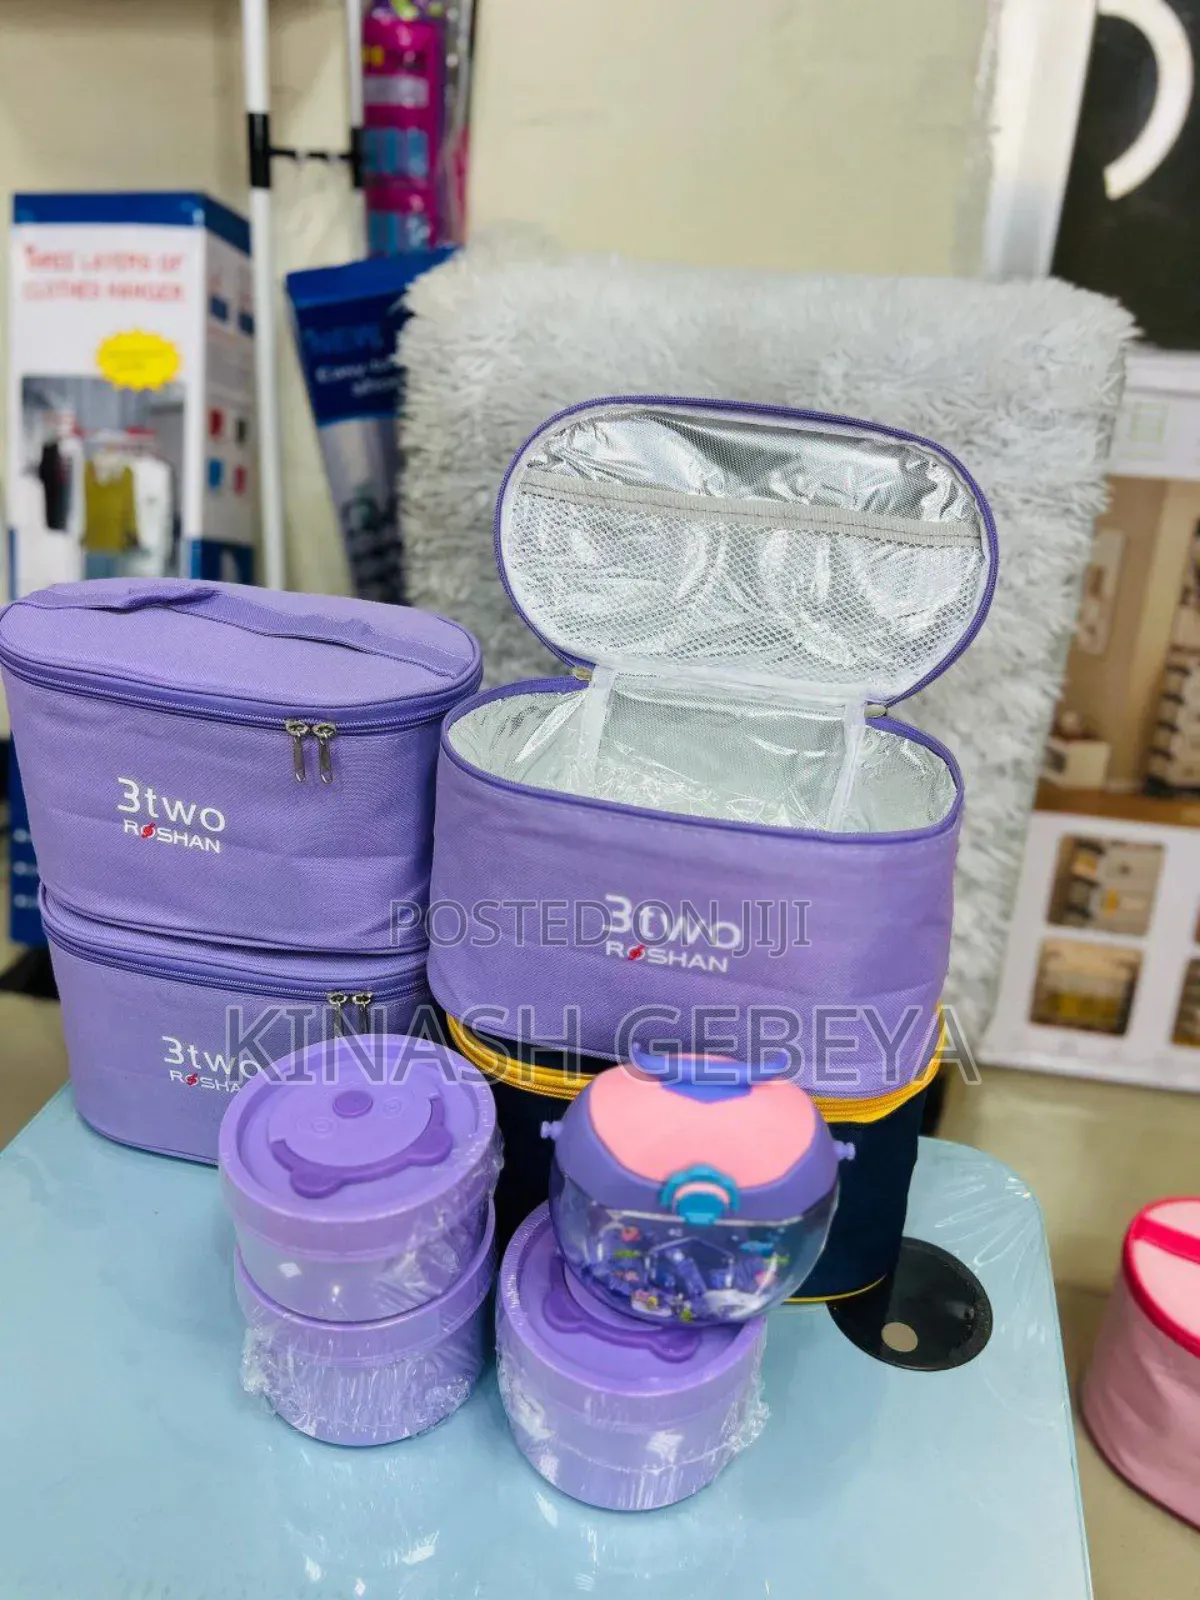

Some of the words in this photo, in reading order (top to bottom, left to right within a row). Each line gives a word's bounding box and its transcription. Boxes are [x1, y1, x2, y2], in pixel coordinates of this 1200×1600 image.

[117, 777, 226, 833] 3two
[122, 818, 221, 854] ROSHAN
[605, 939, 729, 973] ROSHAN
[169, 1069, 242, 1094] ROSHA
